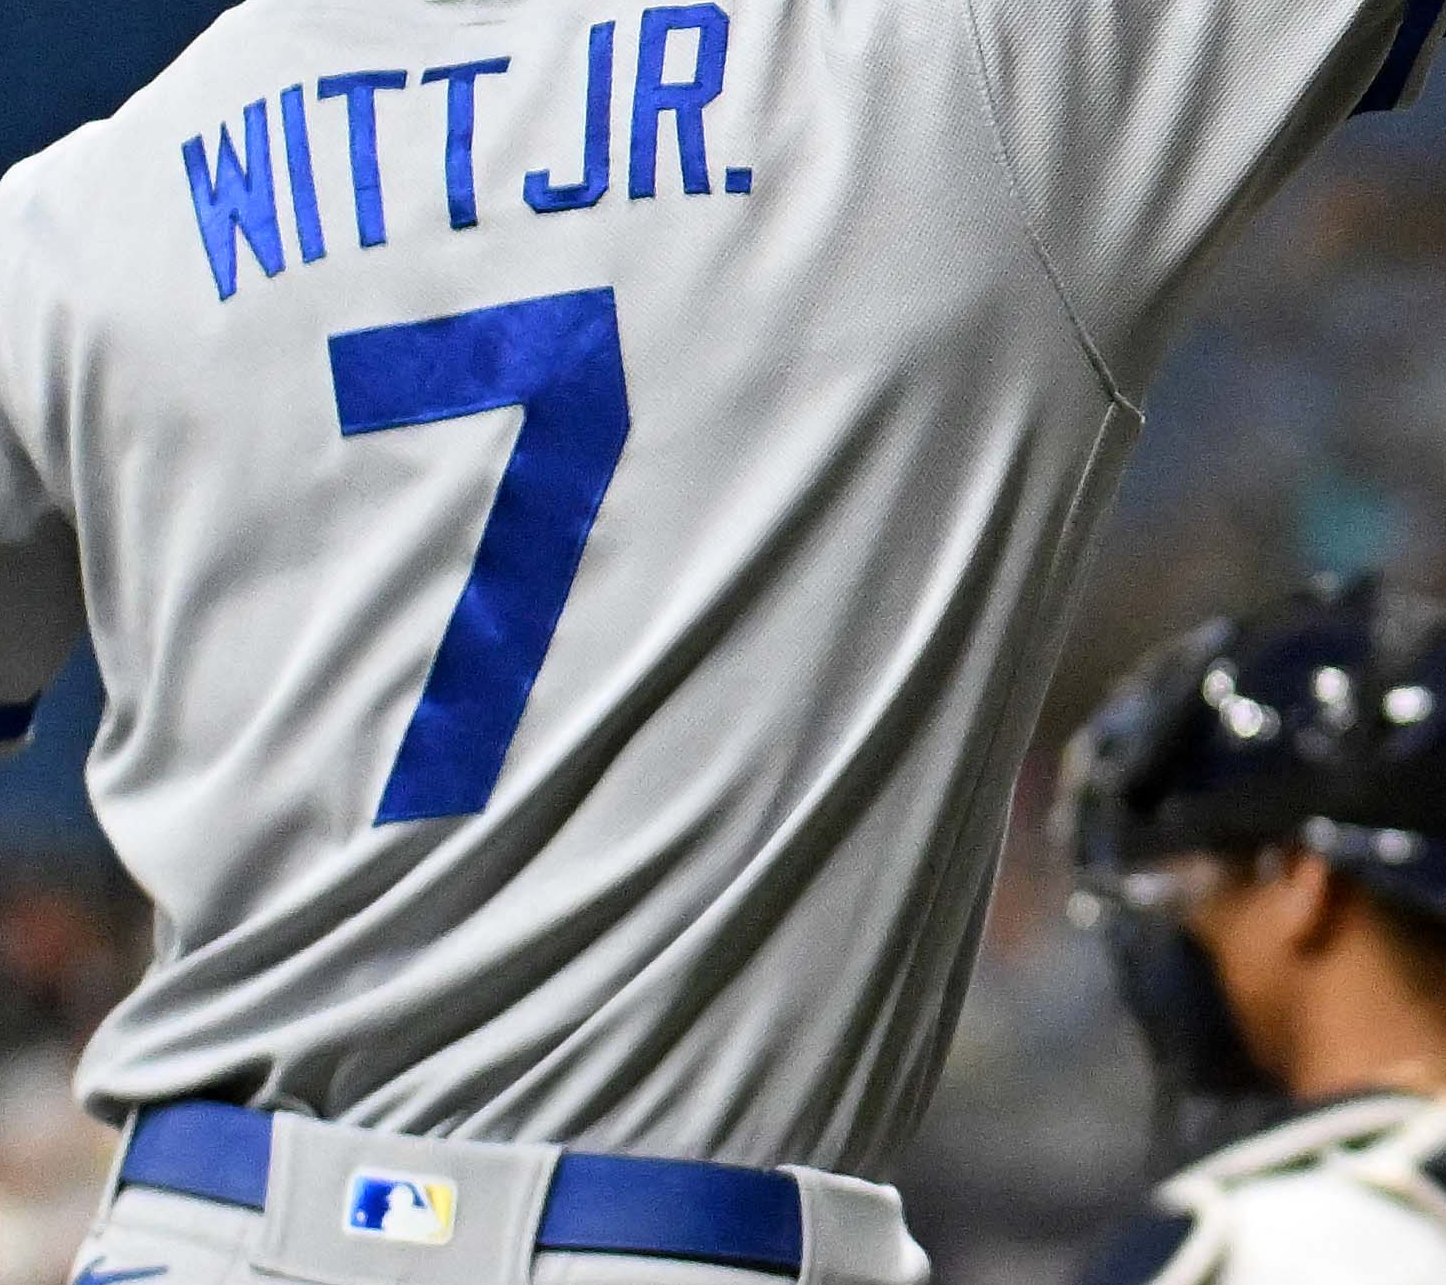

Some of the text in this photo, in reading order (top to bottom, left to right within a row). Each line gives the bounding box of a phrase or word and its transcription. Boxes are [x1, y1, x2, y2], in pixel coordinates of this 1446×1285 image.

[181, 2, 753, 301] WITT JR.
[327, 286, 632, 827] 7
